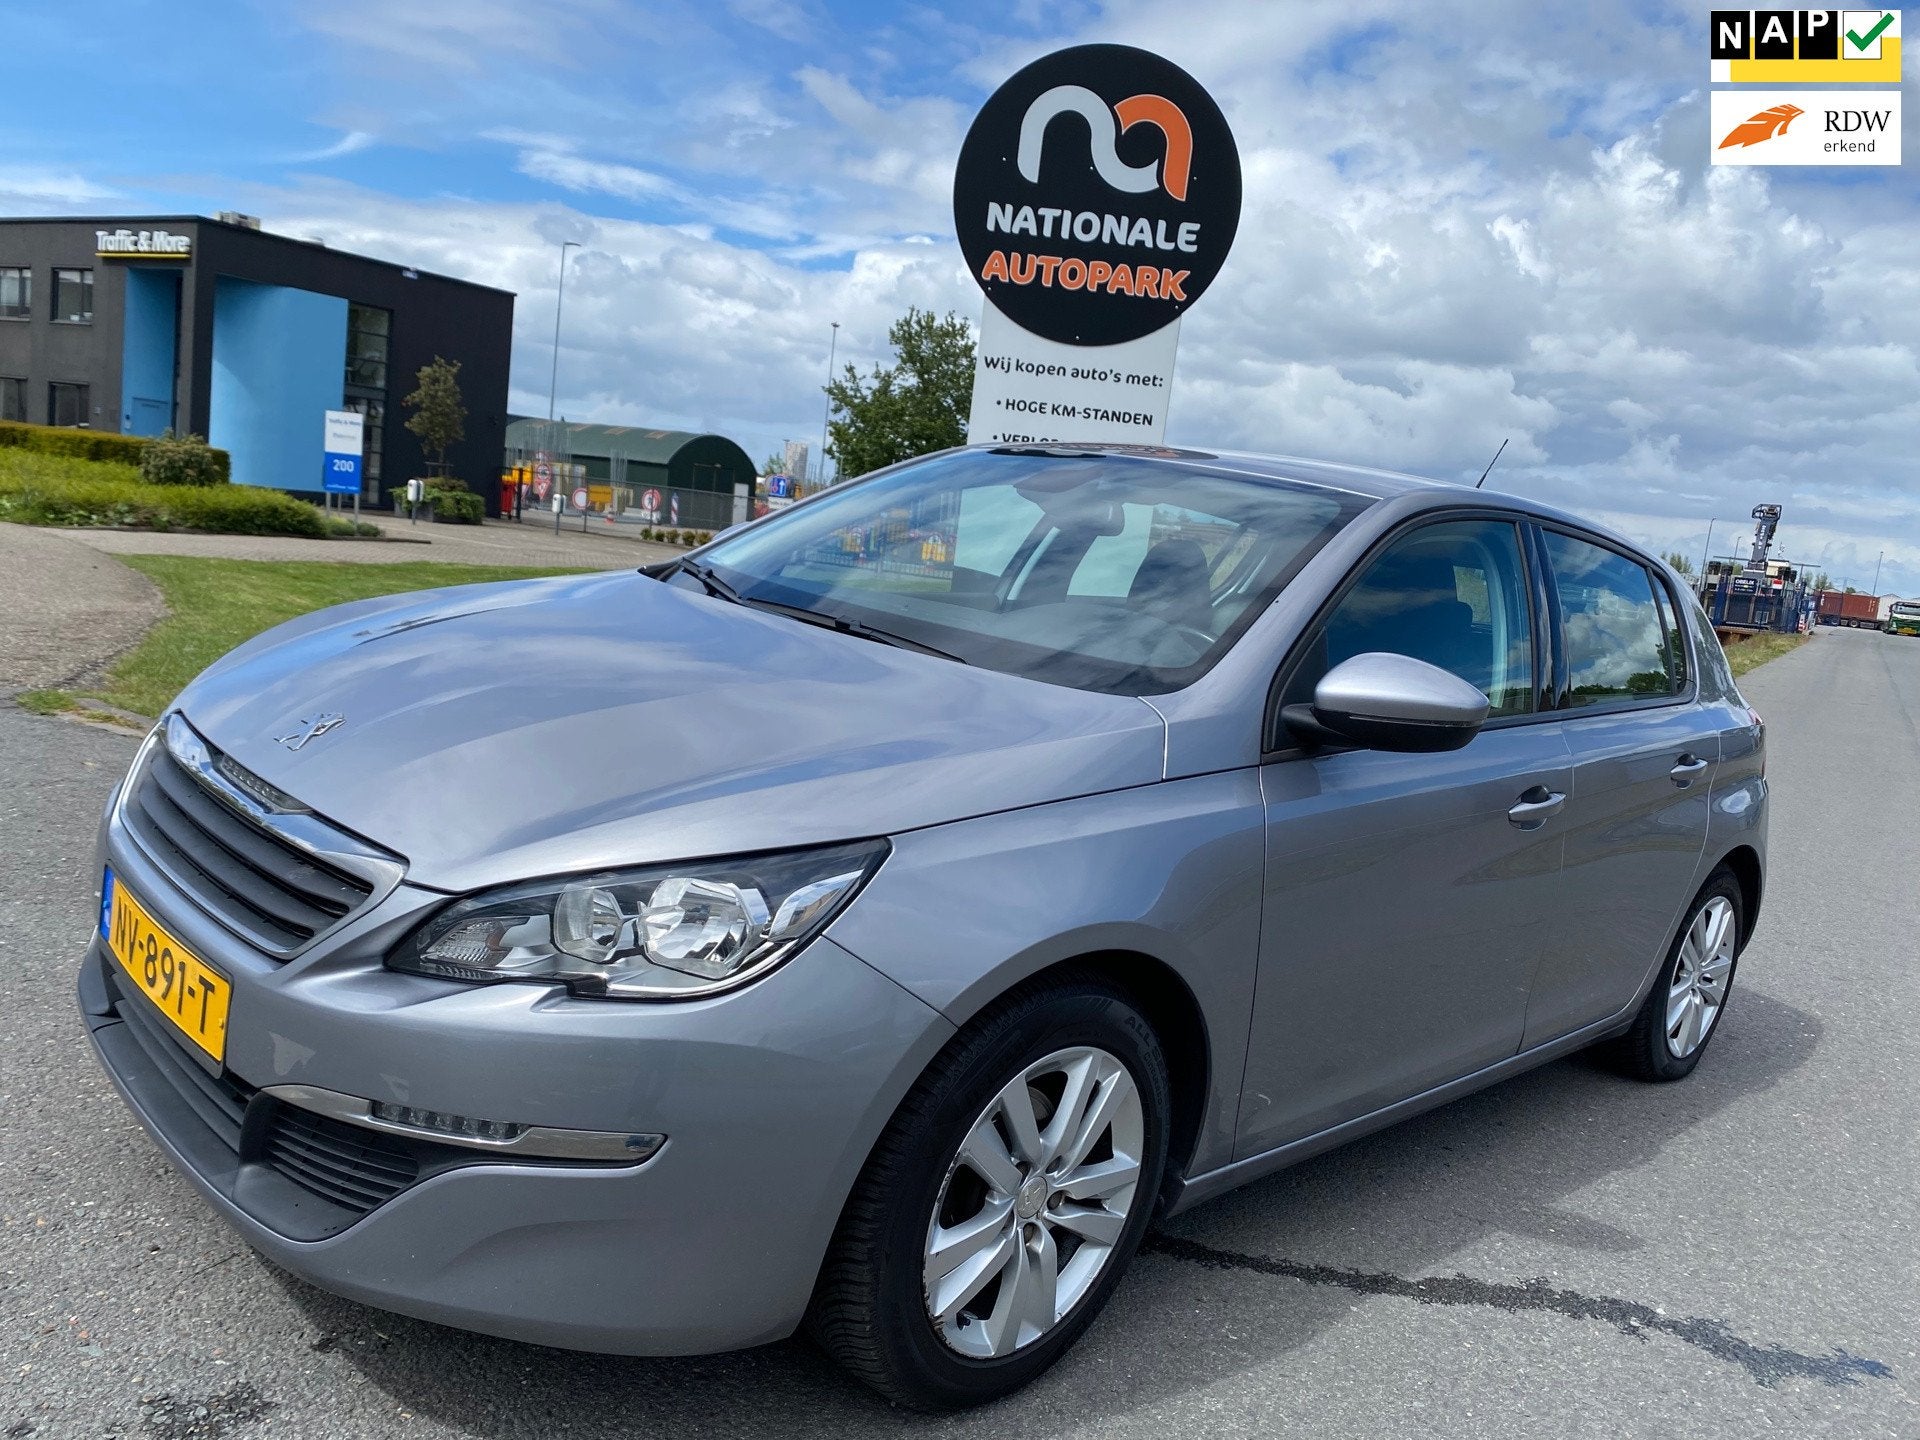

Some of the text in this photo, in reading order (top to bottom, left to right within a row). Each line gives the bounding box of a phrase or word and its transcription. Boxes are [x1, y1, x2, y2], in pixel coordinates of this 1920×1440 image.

[152, 231, 191, 253] More
[986, 201, 1201, 253] NATIONALE
[981, 249, 1191, 301] AUTOPARK
[984, 356, 1163, 388] Wij kopen auto's met:
[1005, 398, 1153, 426] HOGE KM-STANDEN
[332, 459, 354, 472] 200
[115, 896, 215, 1035] NV-891-T
